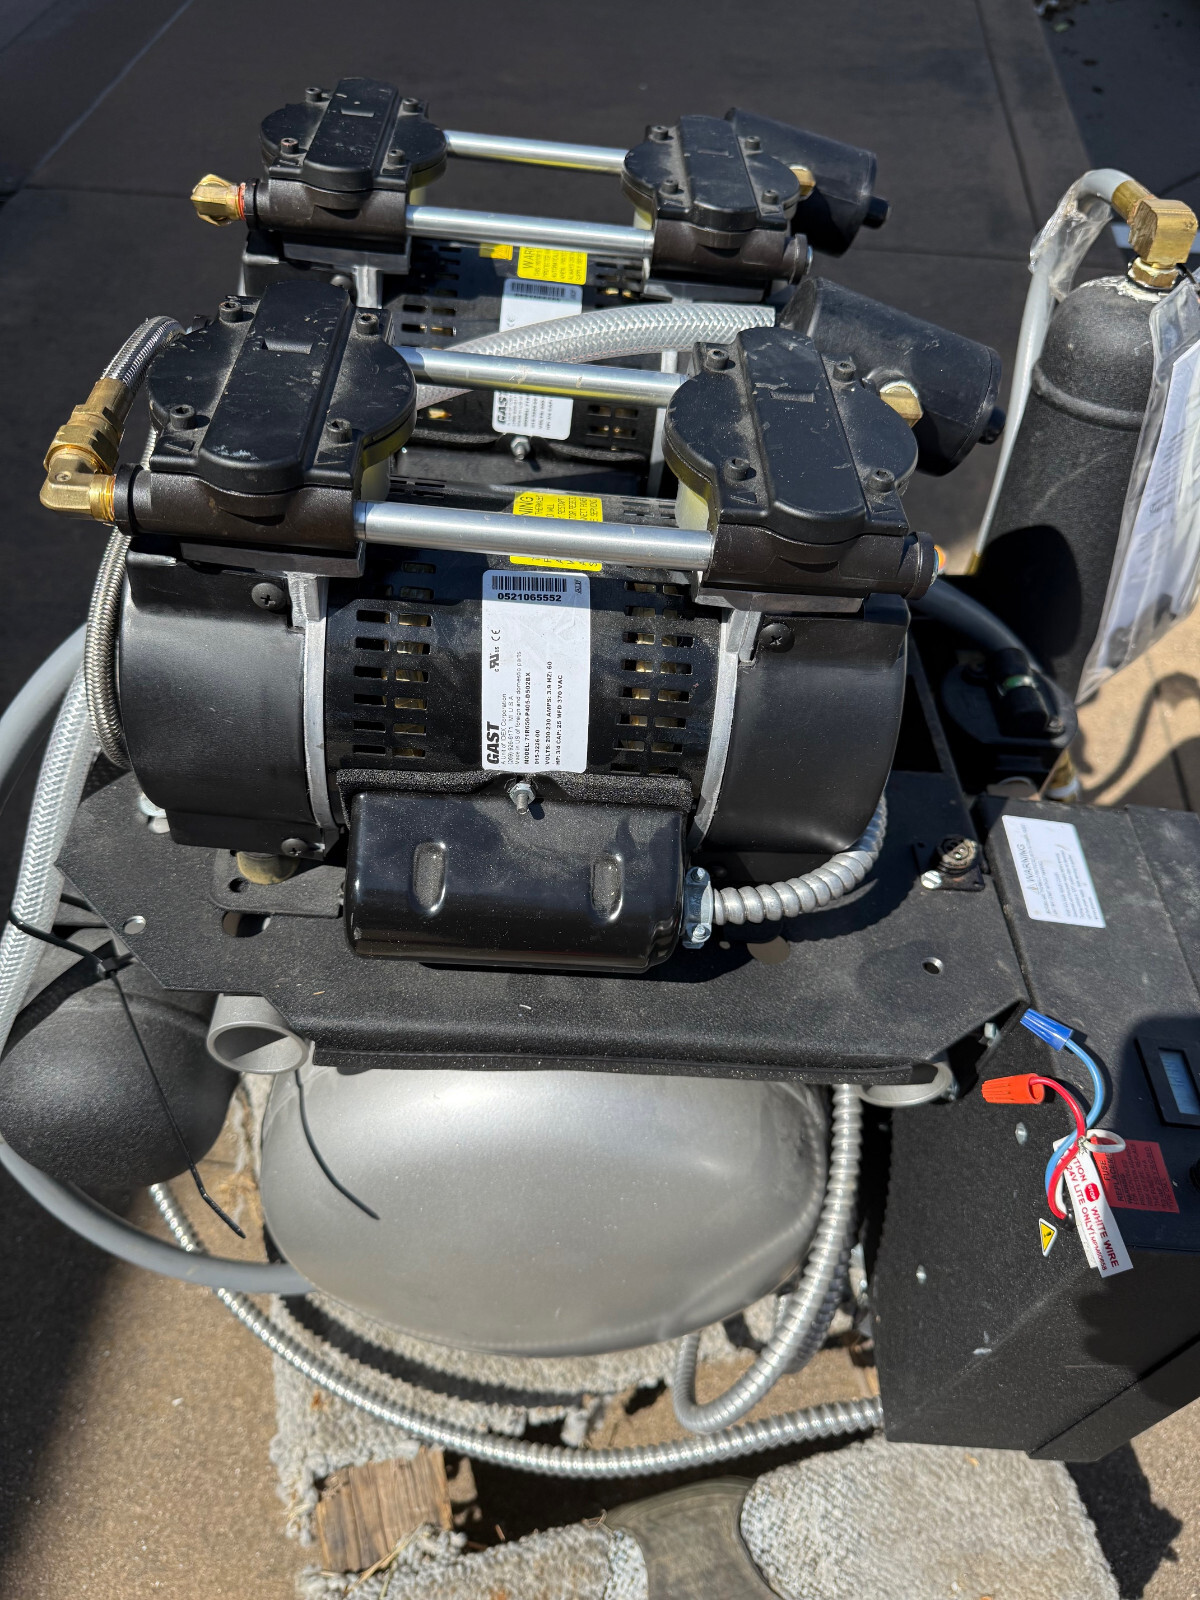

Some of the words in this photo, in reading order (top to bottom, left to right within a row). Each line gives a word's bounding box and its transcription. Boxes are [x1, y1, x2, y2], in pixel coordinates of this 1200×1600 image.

[498, 592, 562, 602] 0521065552
[547, 661, 552, 670] 60
[487, 721, 499, 764] GAST
[1100, 1160, 1110, 1180] FUSE
[1074, 1184, 1086, 1206] LITE
[1088, 1185, 1096, 1200] STOP
[1091, 1206, 1108, 1239] WHITE
[1104, 1240, 1120, 1268] WIRE
